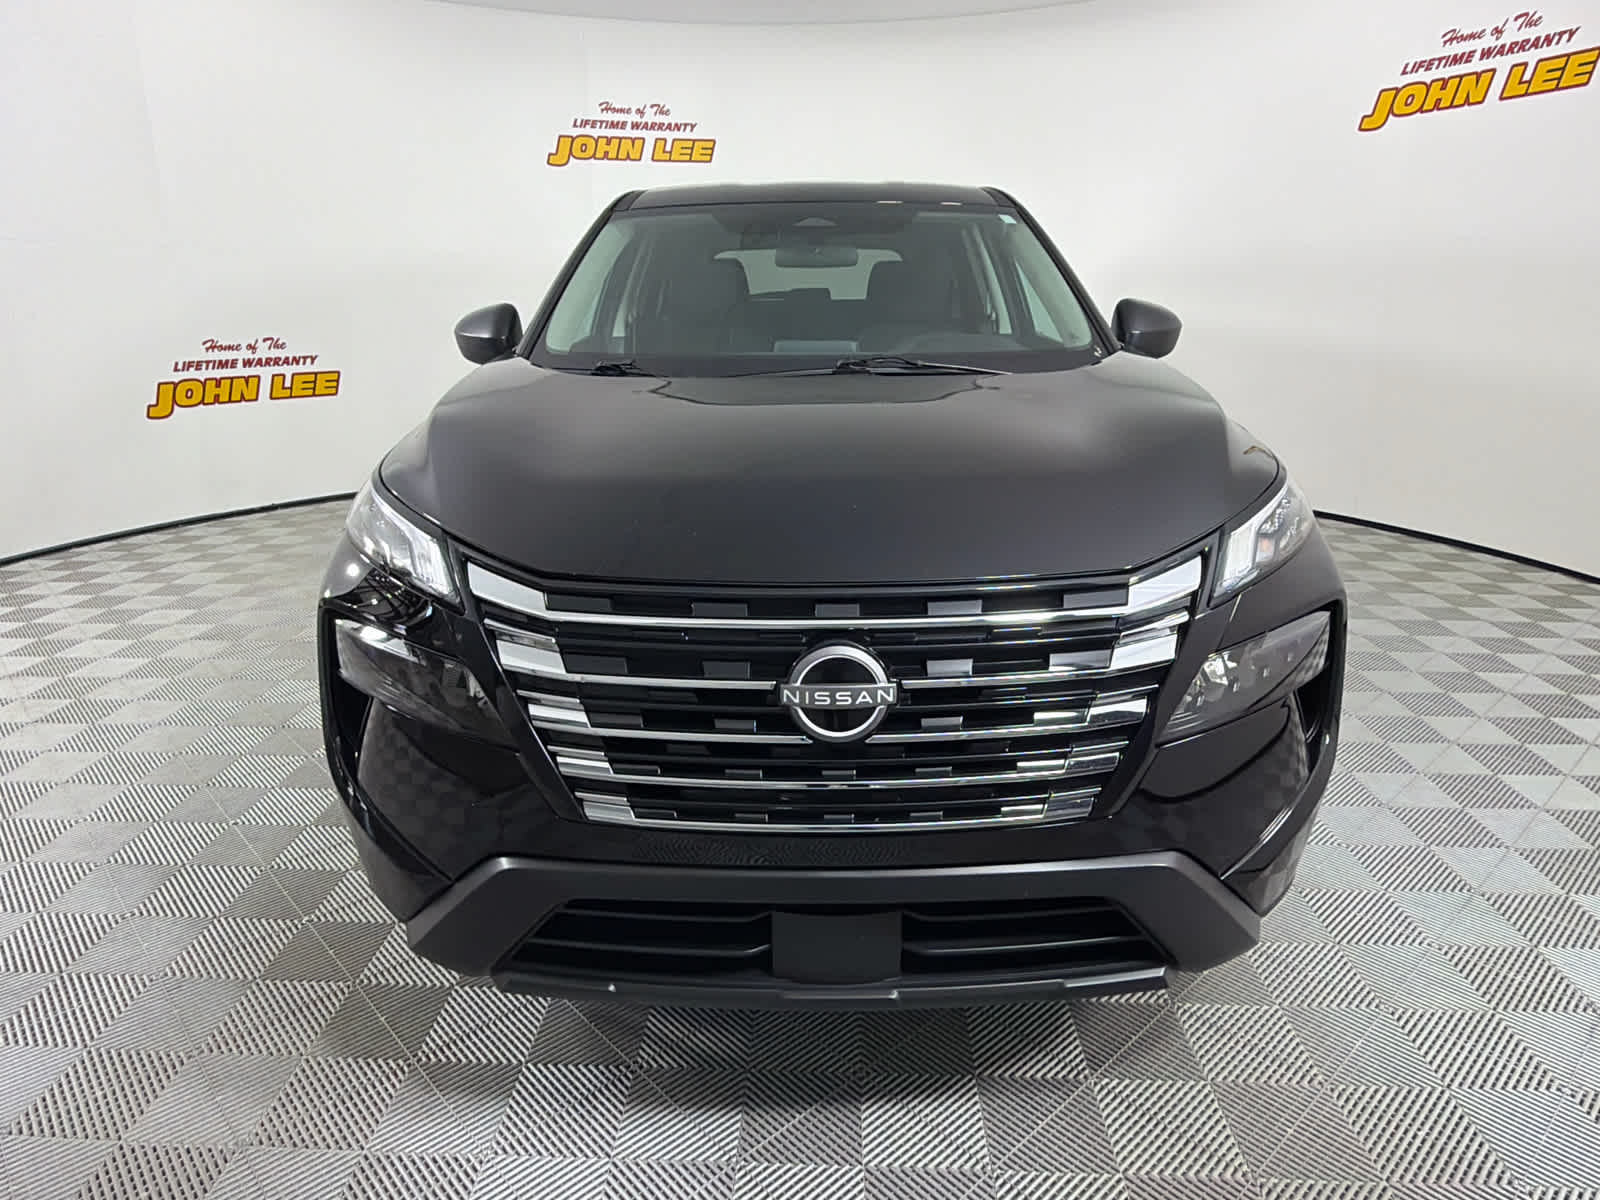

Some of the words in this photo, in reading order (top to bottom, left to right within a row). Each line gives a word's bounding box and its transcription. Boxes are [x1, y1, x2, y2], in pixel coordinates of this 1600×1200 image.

[1441, 28, 1486, 47] Home
[1490, 18, 1509, 40] of
[1513, 10, 1543, 32] The
[1400, 49, 1477, 76] LIFETIME
[1478, 26, 1581, 62] WARRANTY
[1358, 68, 1497, 131] JOHN
[1498, 45, 1600, 101] LEE
[598, 101, 632, 116] Home
[635, 105, 647, 119] of
[650, 103, 671, 117] The
[572, 118, 627, 130] LIFETIME
[630, 120, 698, 133] WARRANTY
[547, 134, 645, 167] JOHN
[651, 137, 716, 163] LEE
[202, 338, 243, 353] Home
[246, 338, 258, 354] of
[262, 337, 287, 351] The
[173, 357, 238, 372] LIFETIME
[242, 354, 319, 369] WARRANTY
[146, 374, 261, 419] JOHN
[269, 370, 341, 400] LEE
[783, 688, 893, 705] NISSAN
